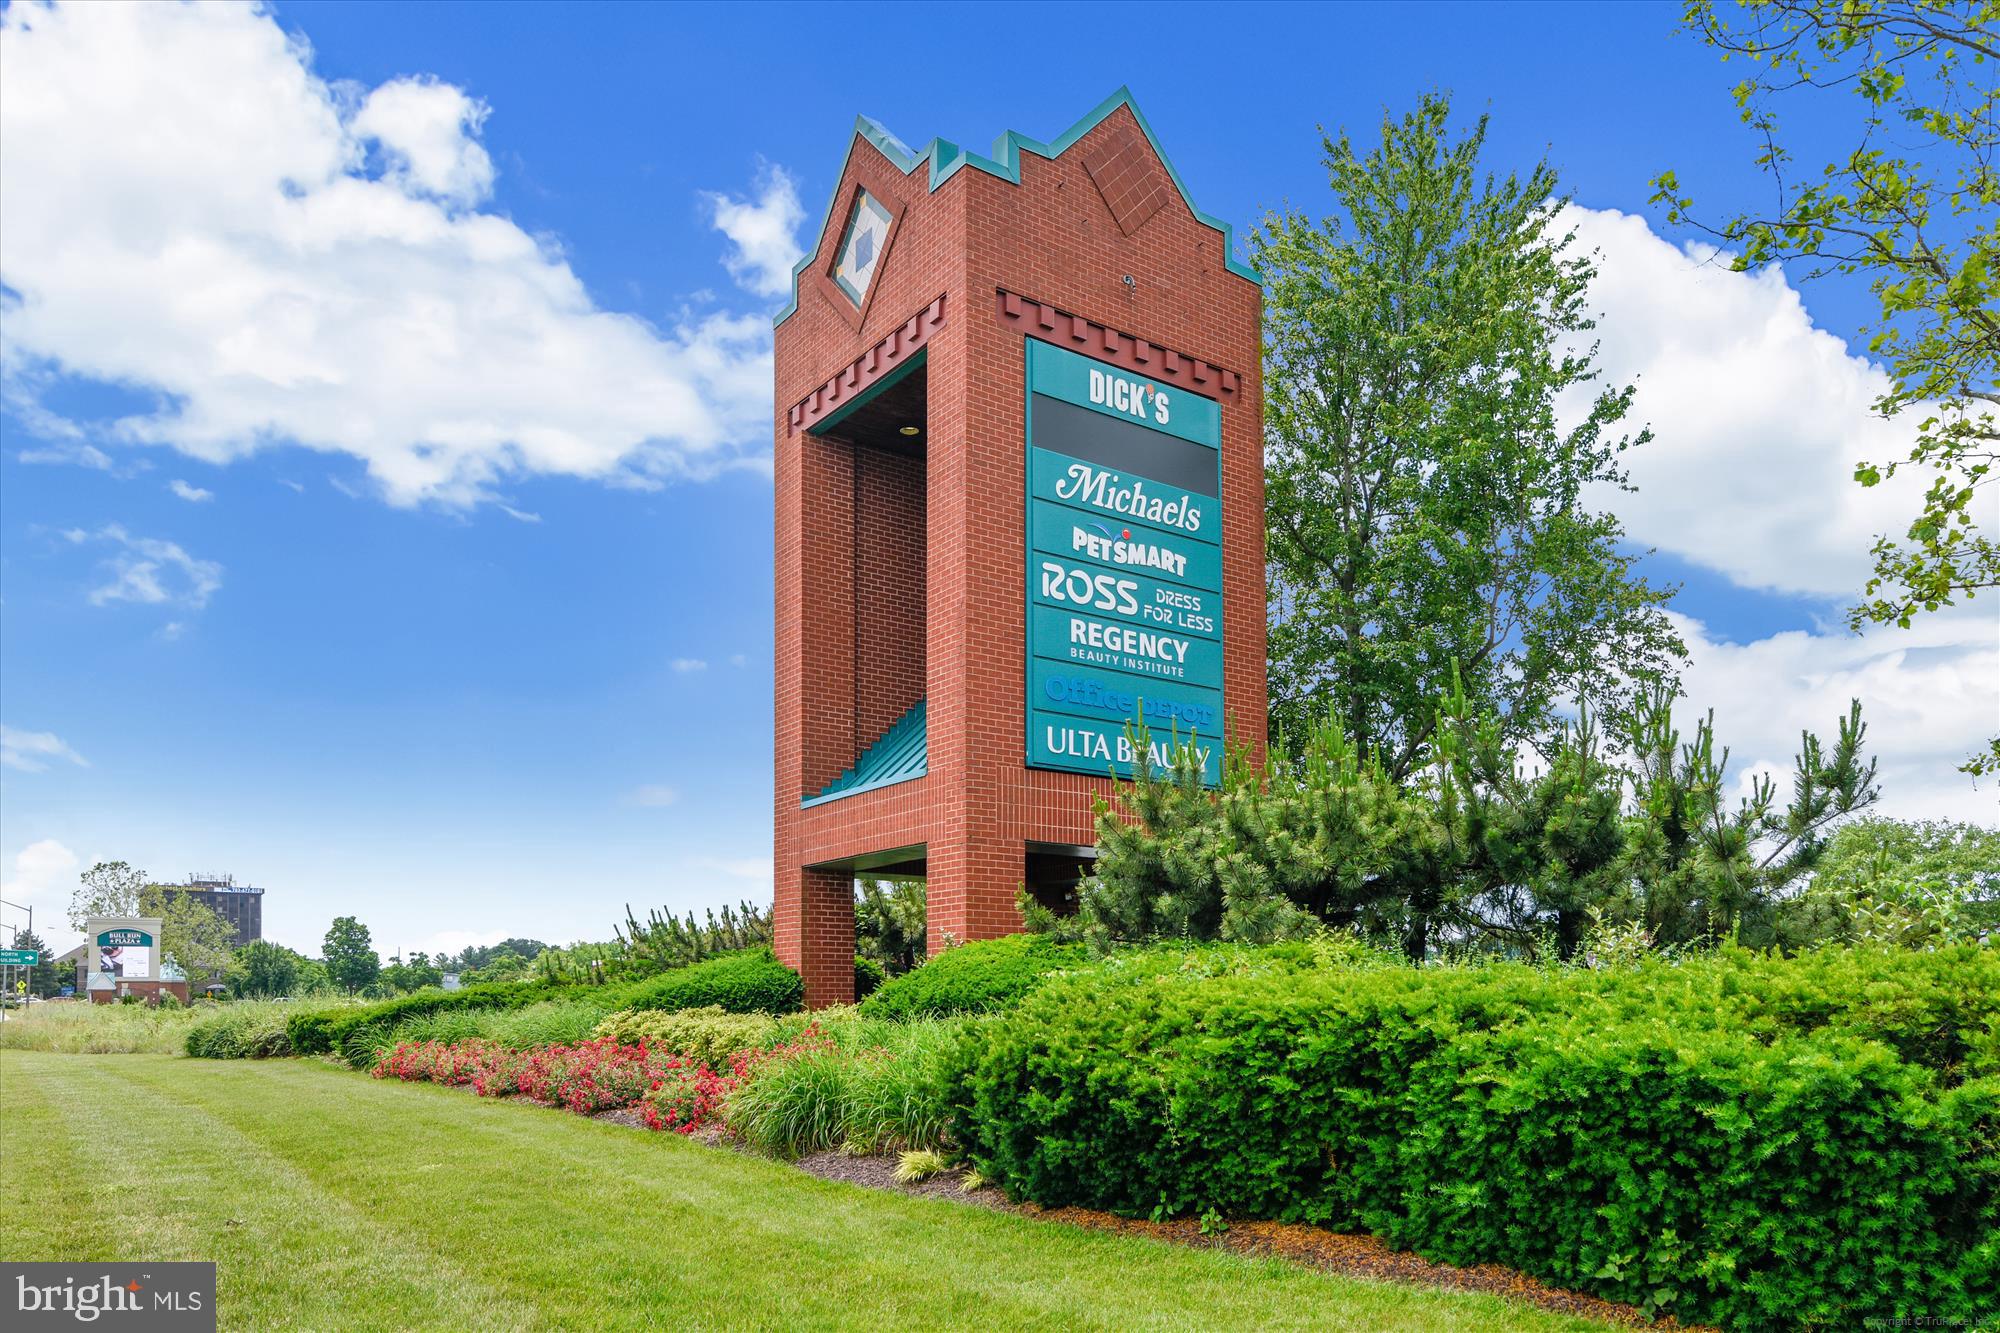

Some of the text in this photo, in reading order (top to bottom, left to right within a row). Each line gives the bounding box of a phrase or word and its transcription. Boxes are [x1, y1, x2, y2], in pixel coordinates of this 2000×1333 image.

[1089, 368, 1169, 425] DICK'S
[1056, 464, 1201, 532] Michaels
[1042, 562, 1139, 616] ROSS
[1156, 588, 1201, 612] DRESS
[1070, 618, 1189, 664] REGENCY
[1143, 604, 1214, 633] FOR LESS
[1070, 647, 1184, 678] BEAUTY INSTITUTE
[1045, 675, 1213, 726] Office DEPOT
[1047, 725, 1111, 760] ULTA
